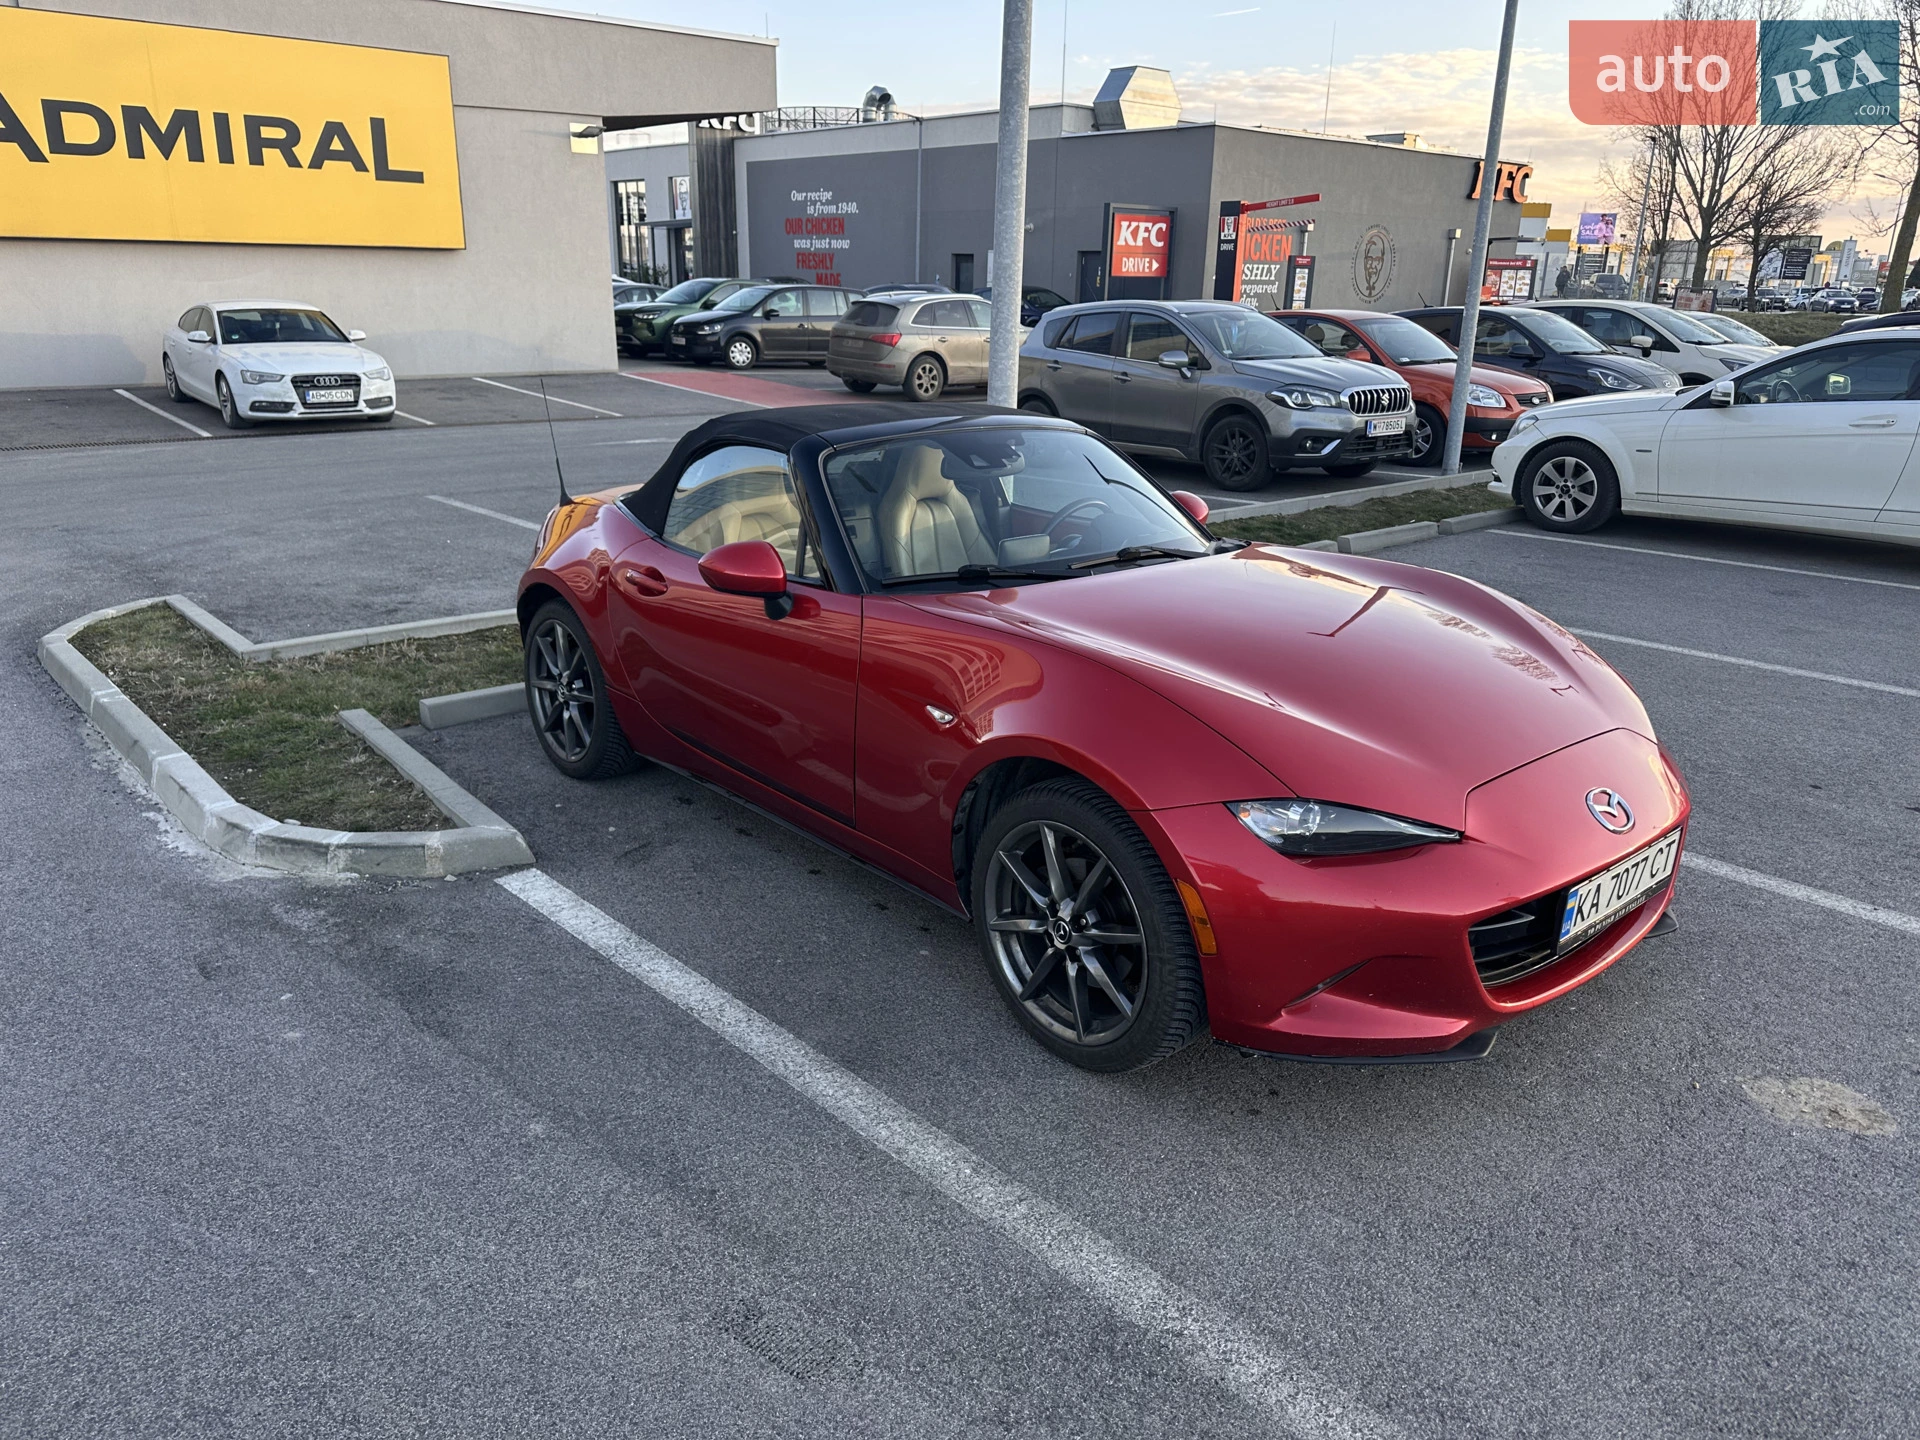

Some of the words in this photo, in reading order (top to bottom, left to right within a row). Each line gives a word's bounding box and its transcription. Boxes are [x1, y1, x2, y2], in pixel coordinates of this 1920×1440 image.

[791, 190, 806, 201] Our
[808, 188, 832, 202] recipe
[807, 202, 814, 214] is
[814, 202, 836, 216] from
[838, 202, 859, 214] 1940.
[785, 218, 803, 235] OUR
[805, 217, 844, 235] CHICKEN
[1117, 220, 1166, 248] KFC
[794, 239, 810, 248] was
[811, 236, 829, 251] just
[831, 239, 850, 249] now
[1220, 243, 1234, 251] DRIVE
[1245, 233, 1292, 262] ICKEN
[796, 252, 834, 270] FRESHLY
[1122, 257, 1149, 273] DRIVE
[816, 272, 841, 286] MADE
[1241, 281, 1279, 295] repared
[1573, 882, 1602, 927] KA
[1605, 855, 1650, 908] 7077
[1650, 838, 1677, 879] CT
